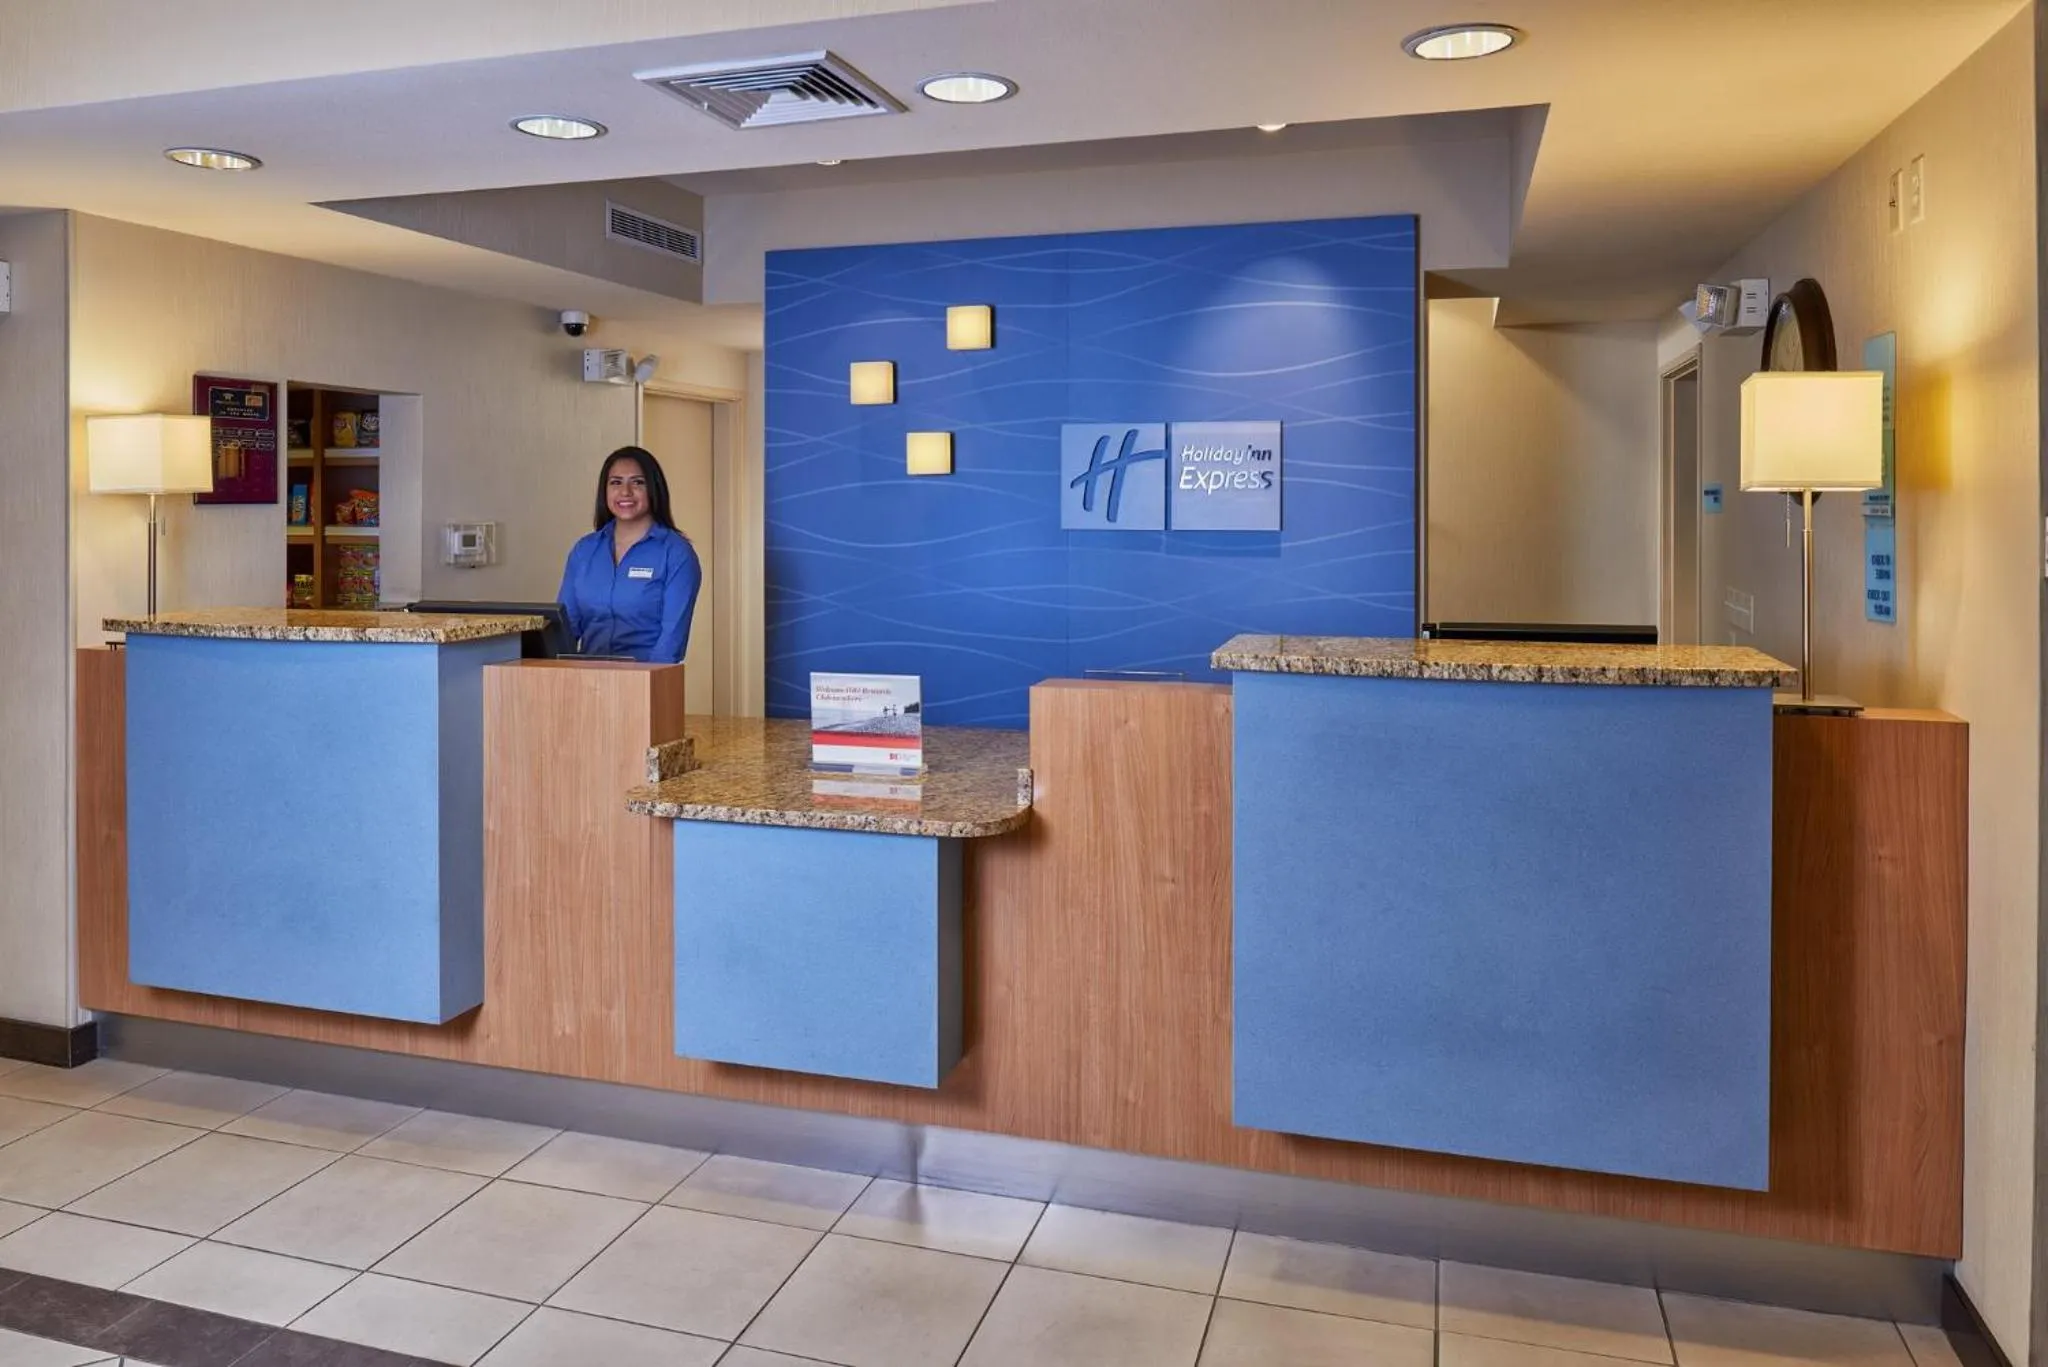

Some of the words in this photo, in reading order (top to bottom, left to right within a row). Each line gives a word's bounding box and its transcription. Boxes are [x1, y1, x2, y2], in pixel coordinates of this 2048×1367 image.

[1180, 445, 1244, 465] Holiday
[1246, 444, 1273, 461] inn
[1179, 466, 1275, 496] Express
